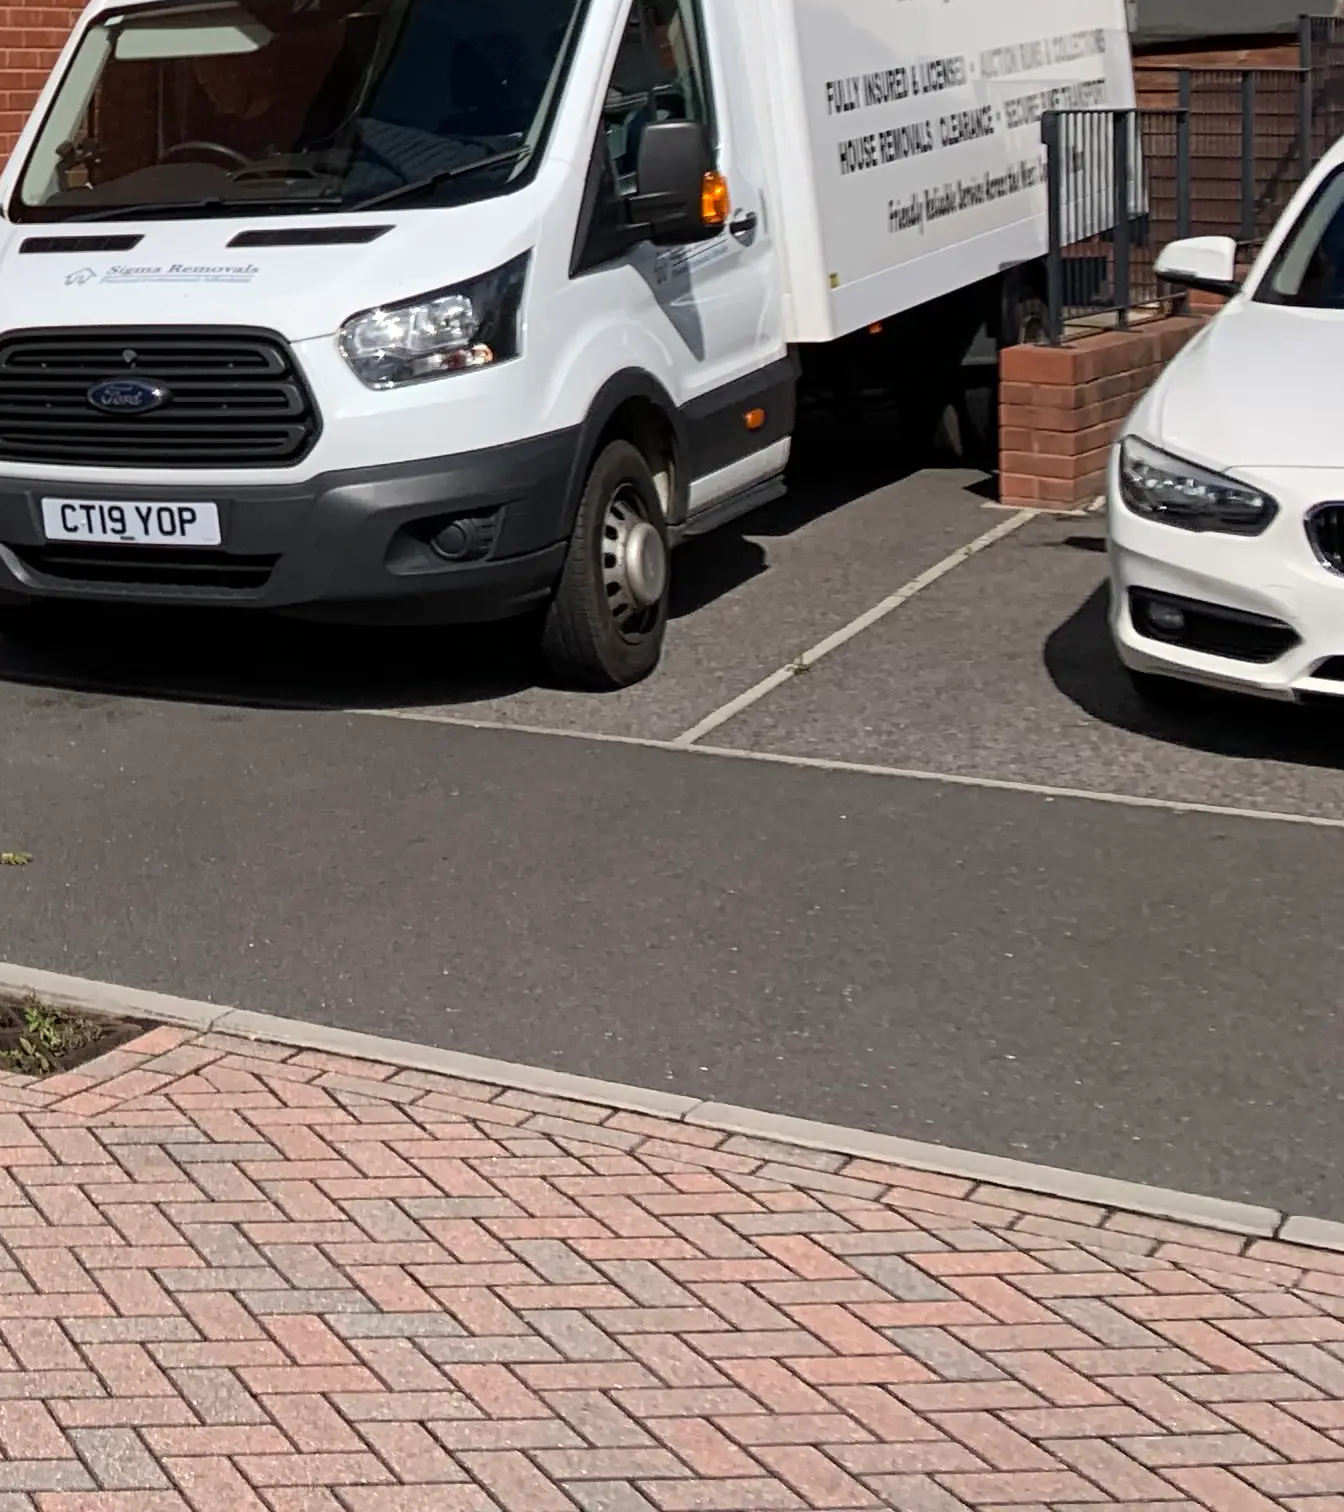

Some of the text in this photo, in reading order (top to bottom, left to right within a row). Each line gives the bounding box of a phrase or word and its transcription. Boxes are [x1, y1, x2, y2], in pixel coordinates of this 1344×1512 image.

[106, 264, 260, 275] Sigma Removals
[100, 386, 144, 406] Ford
[60, 503, 197, 536] CT19 YOP
